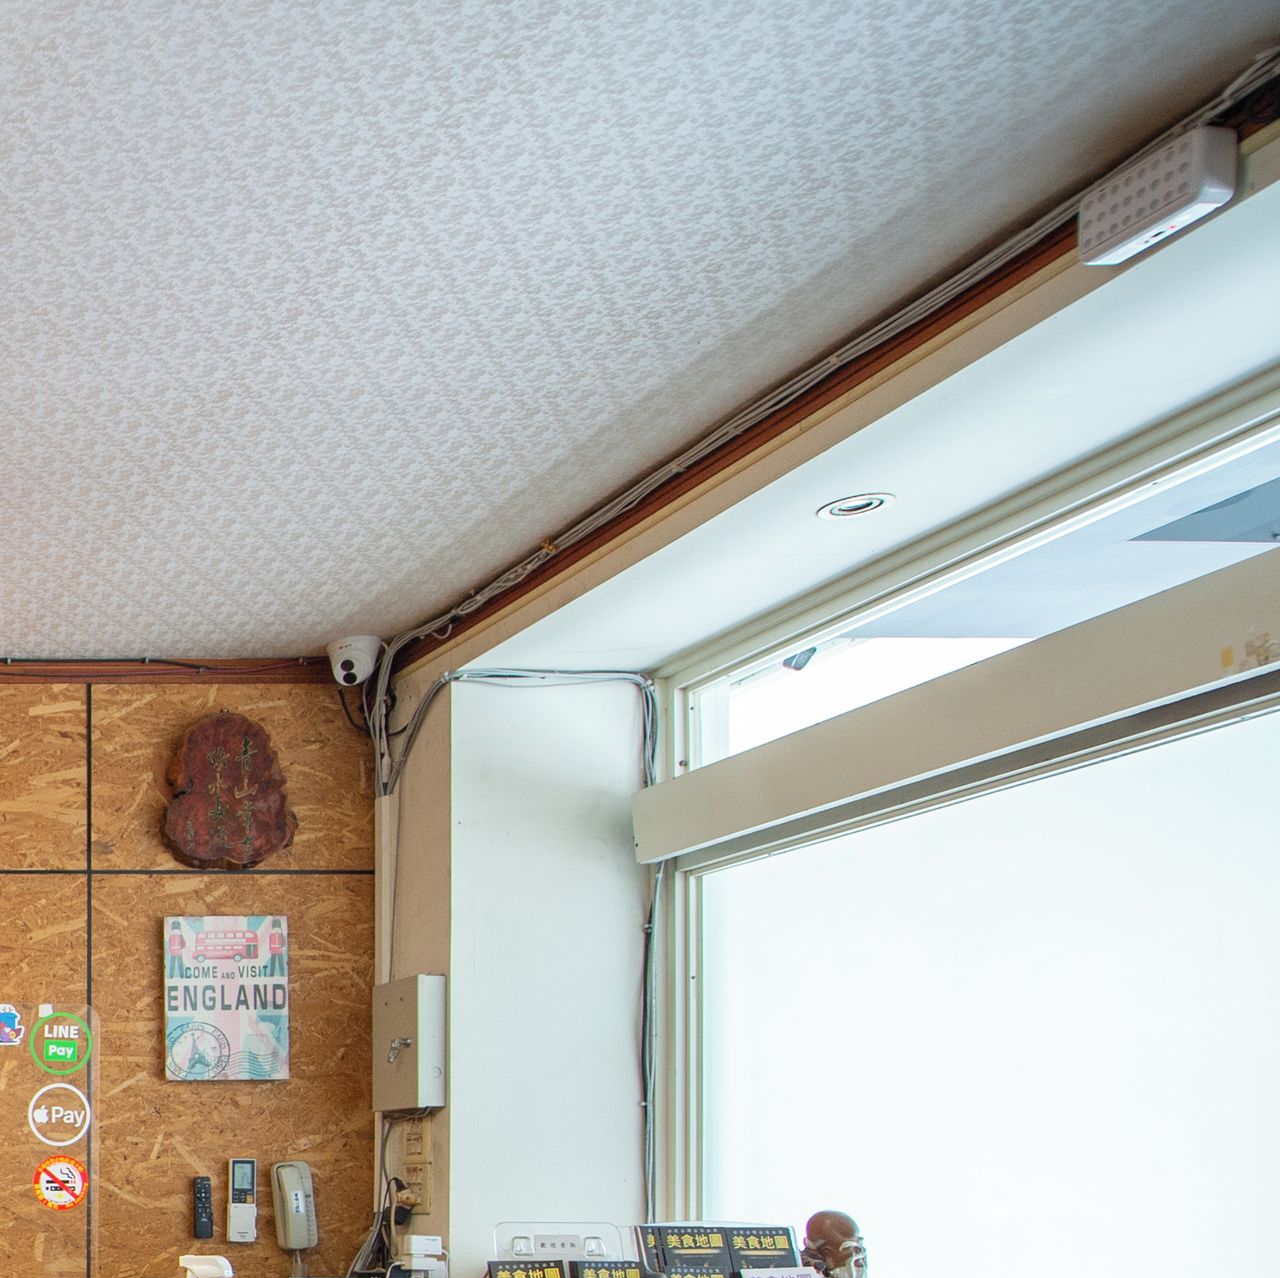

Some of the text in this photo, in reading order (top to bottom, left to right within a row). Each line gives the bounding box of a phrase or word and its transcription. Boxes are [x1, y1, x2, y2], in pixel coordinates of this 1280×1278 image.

[184, 966, 218, 979] COME
[238, 965, 269, 978] VISIT
[167, 983, 287, 1012] ENGLAND
[44, 1025, 79, 1039] LINE
[48, 1044, 74, 1058] Pay
[51, 1106, 86, 1127] Pay
[666, 1233, 724, 1249] 美食地圖
[732, 1235, 789, 1250] 美食地圖
